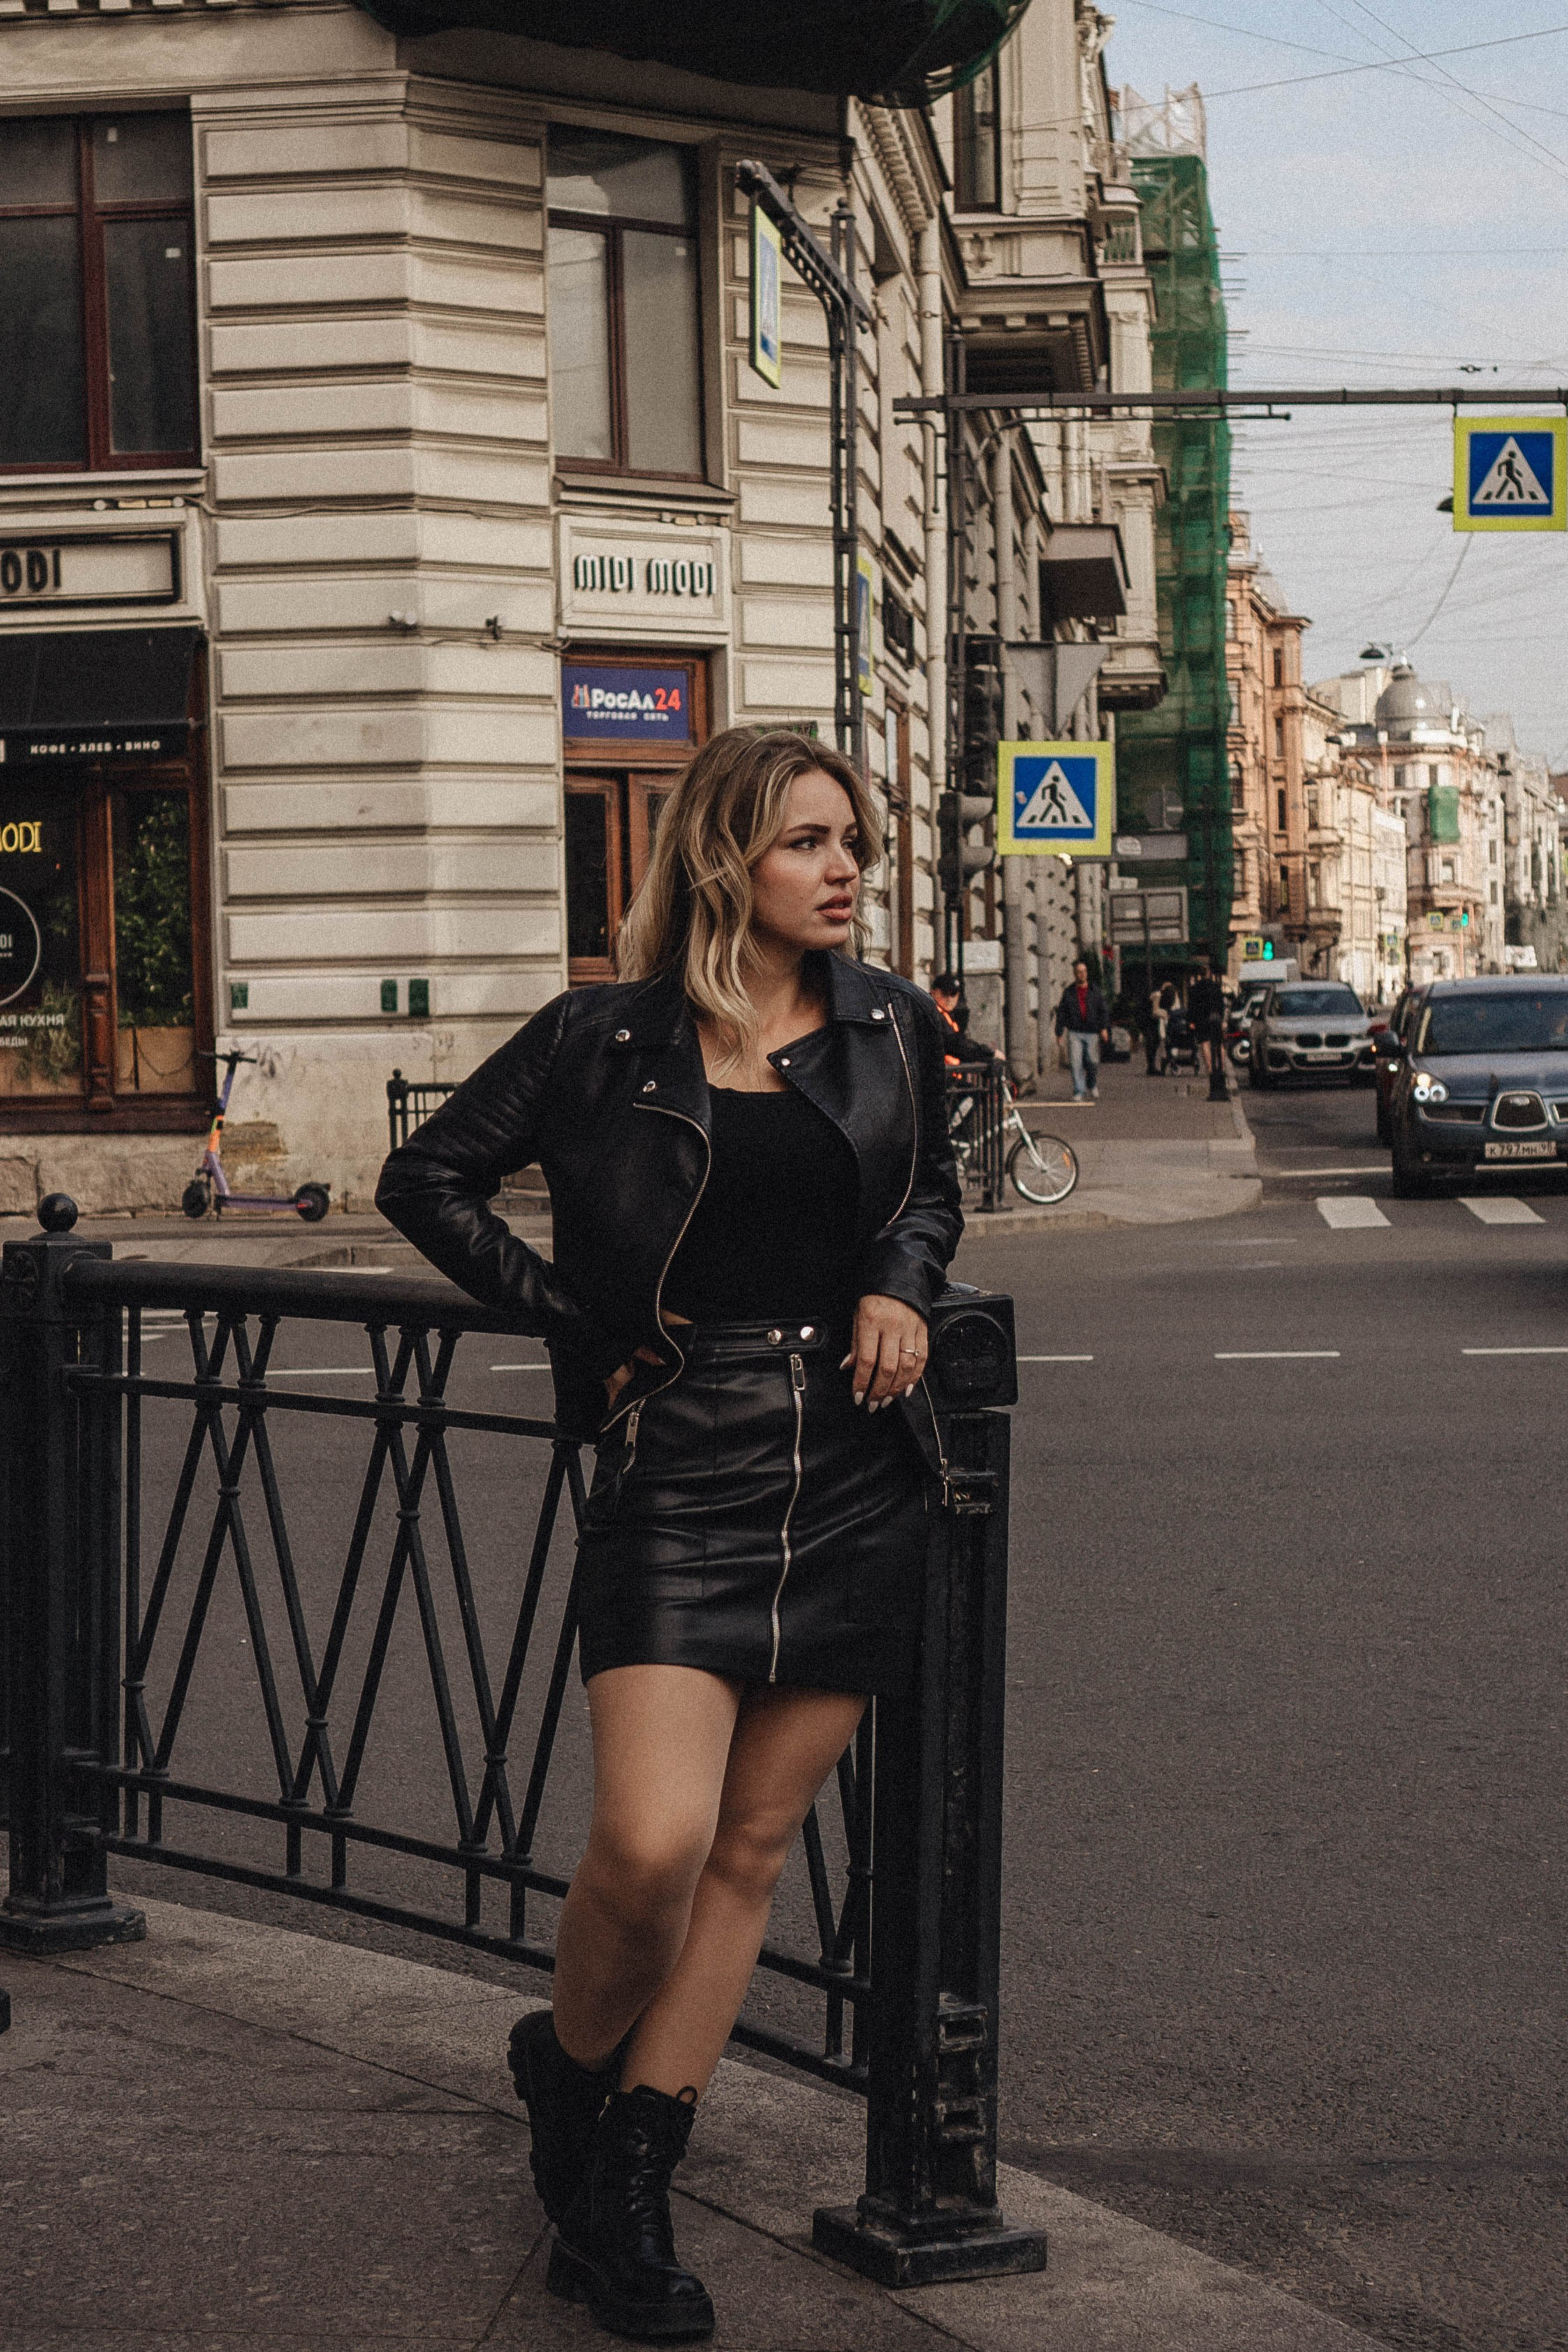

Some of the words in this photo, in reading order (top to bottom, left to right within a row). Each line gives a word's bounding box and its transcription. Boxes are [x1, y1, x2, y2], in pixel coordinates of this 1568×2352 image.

[575, 555, 636, 592] MIDI
[647, 558, 717, 597] MODI
[30, 744, 66, 754] КОФЕ
[79, 742, 112, 752] ХЛЕБ
[125, 740, 160, 751] ВИНО
[20, 1014, 64, 1027] КУХНЯ
